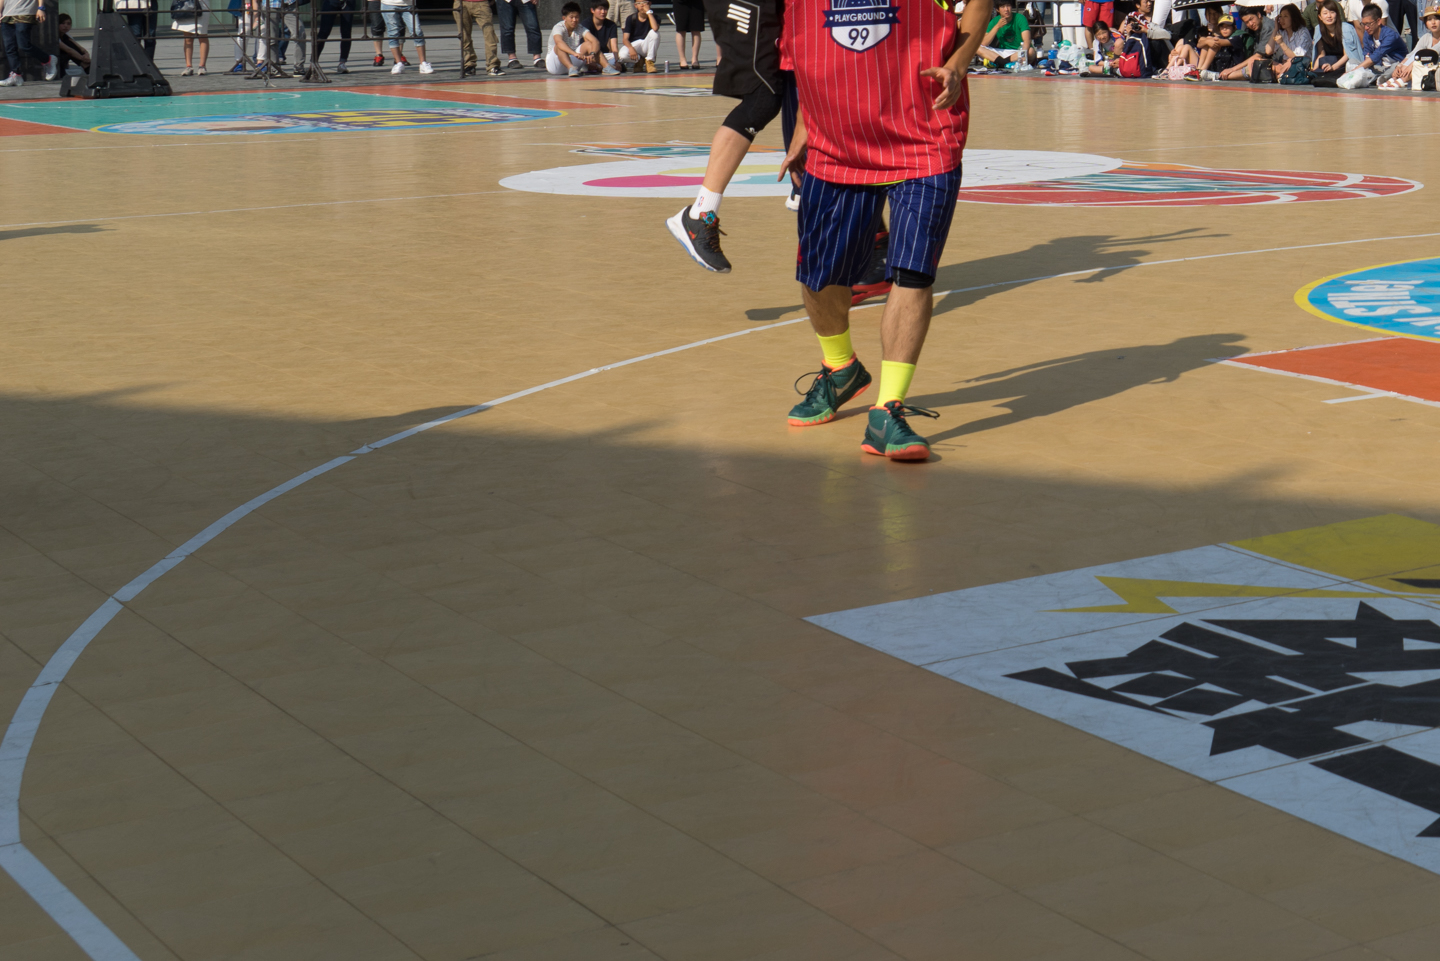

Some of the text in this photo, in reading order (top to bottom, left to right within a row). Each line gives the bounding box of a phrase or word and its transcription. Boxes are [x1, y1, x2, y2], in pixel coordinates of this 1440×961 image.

[834, 11, 886, 23] PLAYGROUND
[848, 27, 870, 46] 99
[1326, 279, 1434, 317] STNet
